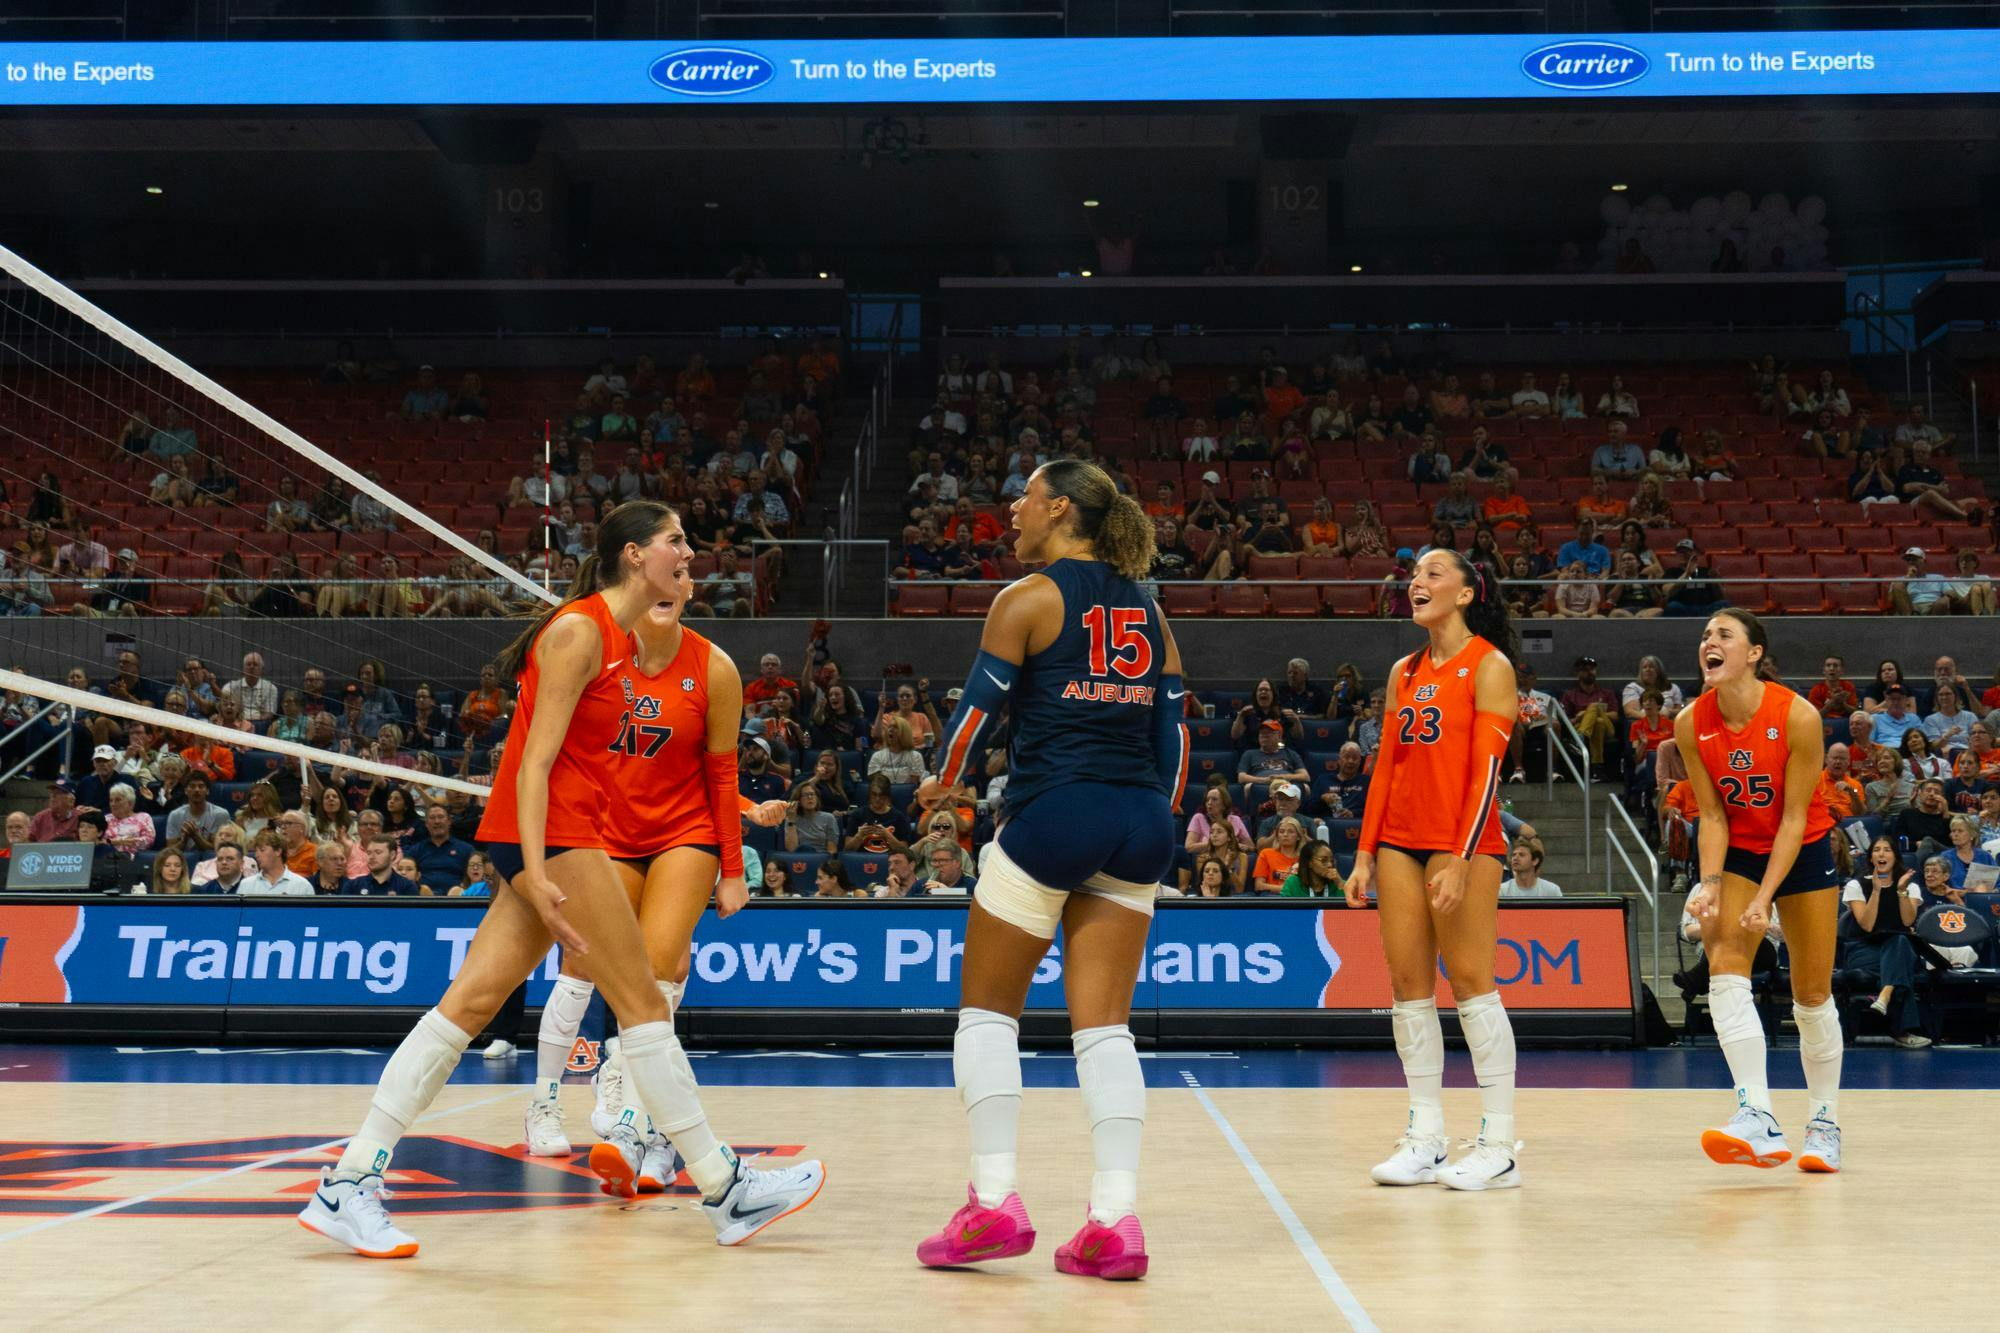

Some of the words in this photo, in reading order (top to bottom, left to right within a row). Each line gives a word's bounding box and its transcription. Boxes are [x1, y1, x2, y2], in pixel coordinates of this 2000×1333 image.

[7, 62, 27, 81] to
[33, 61, 66, 81] the
[73, 61, 154, 86] Experts
[666, 59, 760, 81] Carrier
[790, 59, 839, 79] Turn
[846, 60, 866, 79] to
[873, 59, 907, 79] the
[913, 58, 996, 83] Experts
[1539, 53, 1634, 76] Carrier
[1665, 52, 1715, 72] Turn
[1722, 53, 1742, 72] to
[1749, 51, 1784, 71] the
[1790, 50, 1875, 75] Experts
[495, 188, 545, 214] 103
[1270, 185, 1321, 211] 102
[1082, 605, 1152, 679] 15
[1061, 681, 1156, 706] AUBURN
[1397, 705, 1443, 744] 23
[1718, 773, 1776, 809] 25
[46, 864, 82, 873] REVIEW
[48, 855, 83, 864] VIDEO
[118, 925, 411, 993] Training
